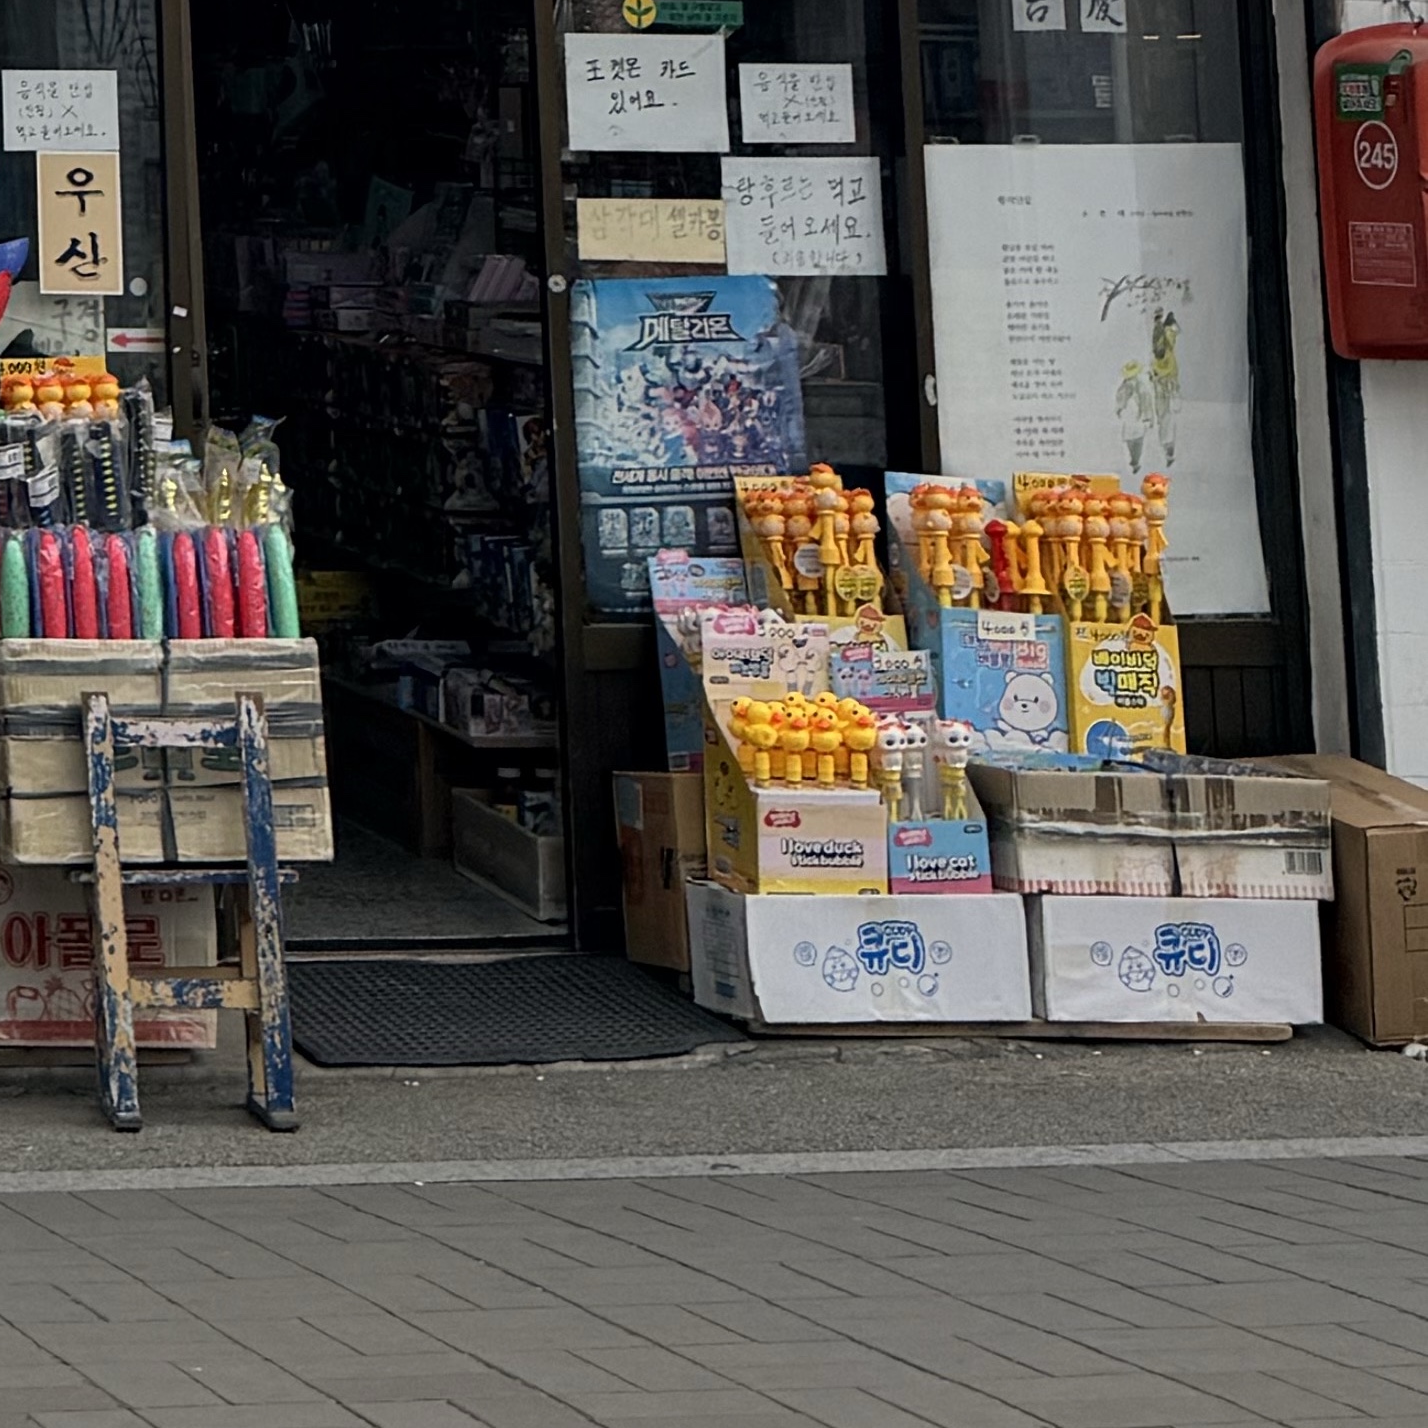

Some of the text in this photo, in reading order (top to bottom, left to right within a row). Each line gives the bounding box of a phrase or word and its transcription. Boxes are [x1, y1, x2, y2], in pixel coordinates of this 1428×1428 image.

[659, 58, 697, 79] 카드
[608, 89, 678, 115] 있어요.
[1358, 140, 1394, 170] 245
[827, 175, 867, 207] 먹고
[789, 838, 823, 856] love
[823, 838, 864, 855] duck
[914, 854, 947, 871] love
[949, 854, 977, 870] cat
